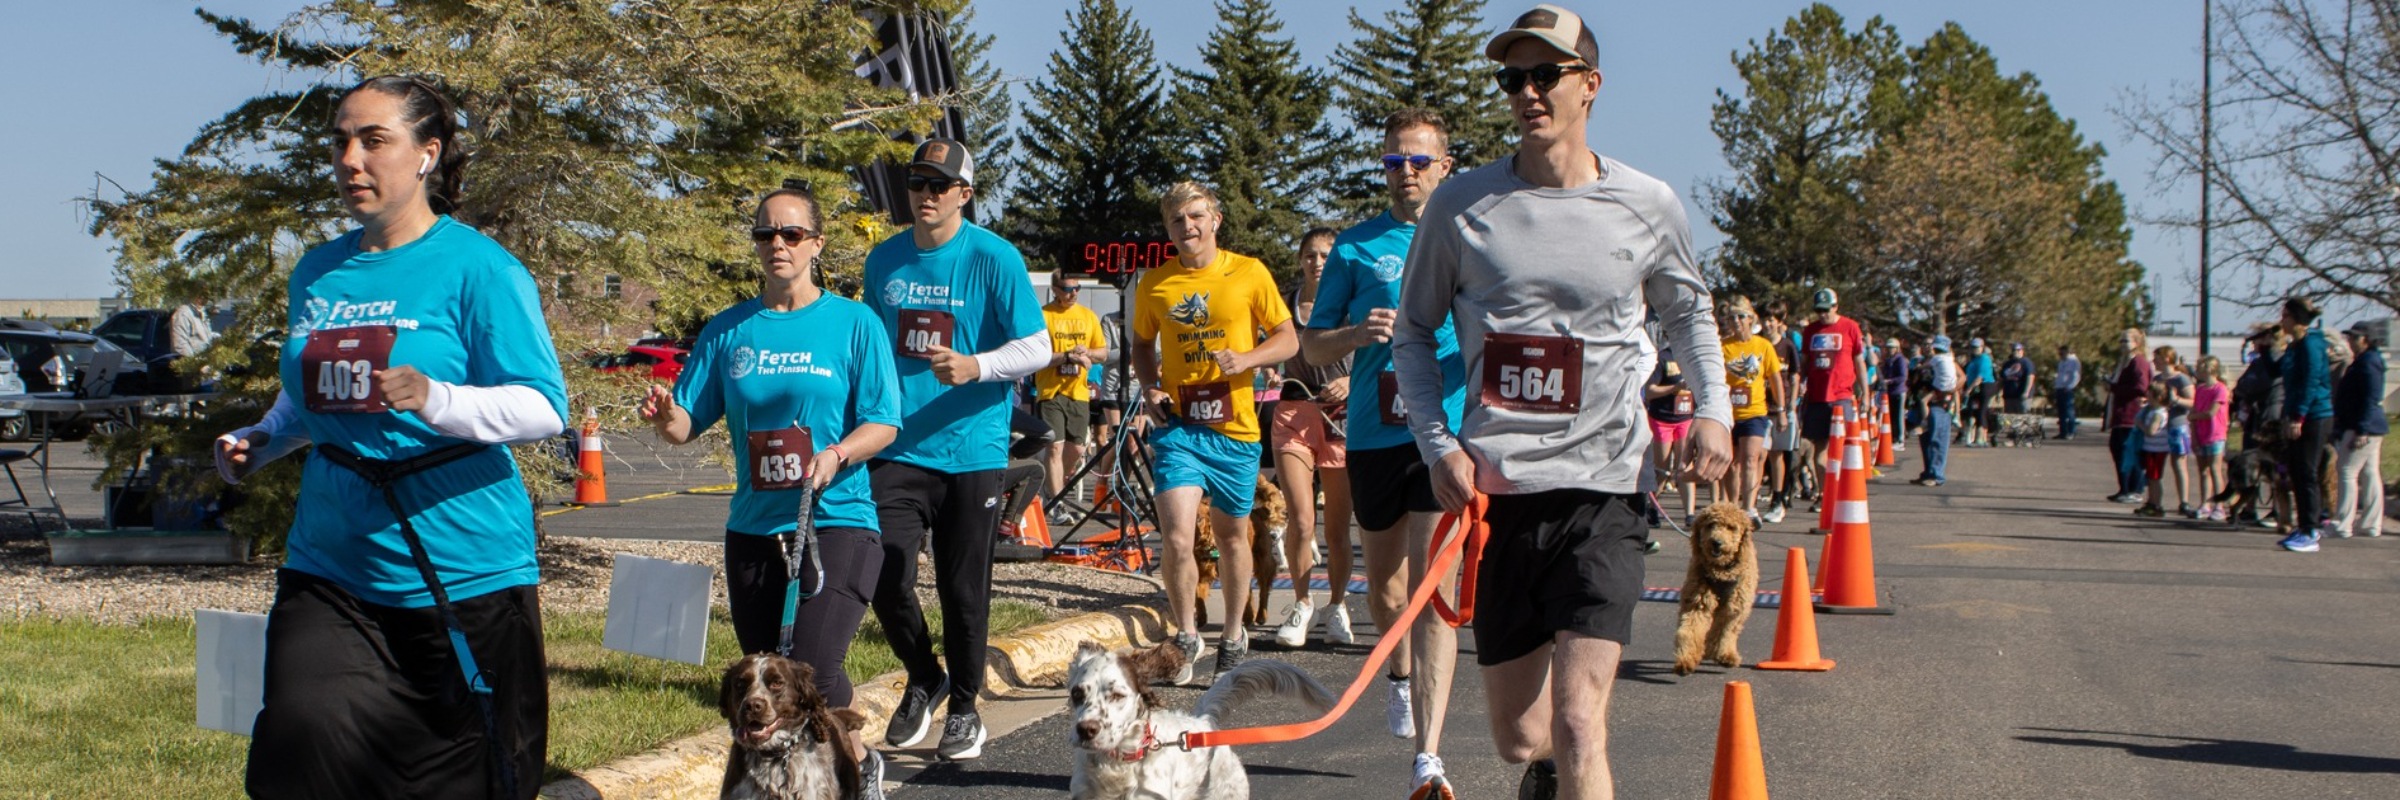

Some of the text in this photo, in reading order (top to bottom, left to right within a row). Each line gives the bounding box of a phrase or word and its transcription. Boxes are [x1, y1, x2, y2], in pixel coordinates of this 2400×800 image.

[905, 329, 942, 353] 404
[1177, 329, 1226, 343] SWIMMING
[1198, 341, 1206, 351] &
[1184, 351, 1217, 363] DIVIN
[317, 359, 372, 401] 403
[1500, 364, 1565, 402] 564
[1189, 399, 1224, 420] 492
[1392, 394, 1408, 418] 4
[760, 453, 803, 482] 433
